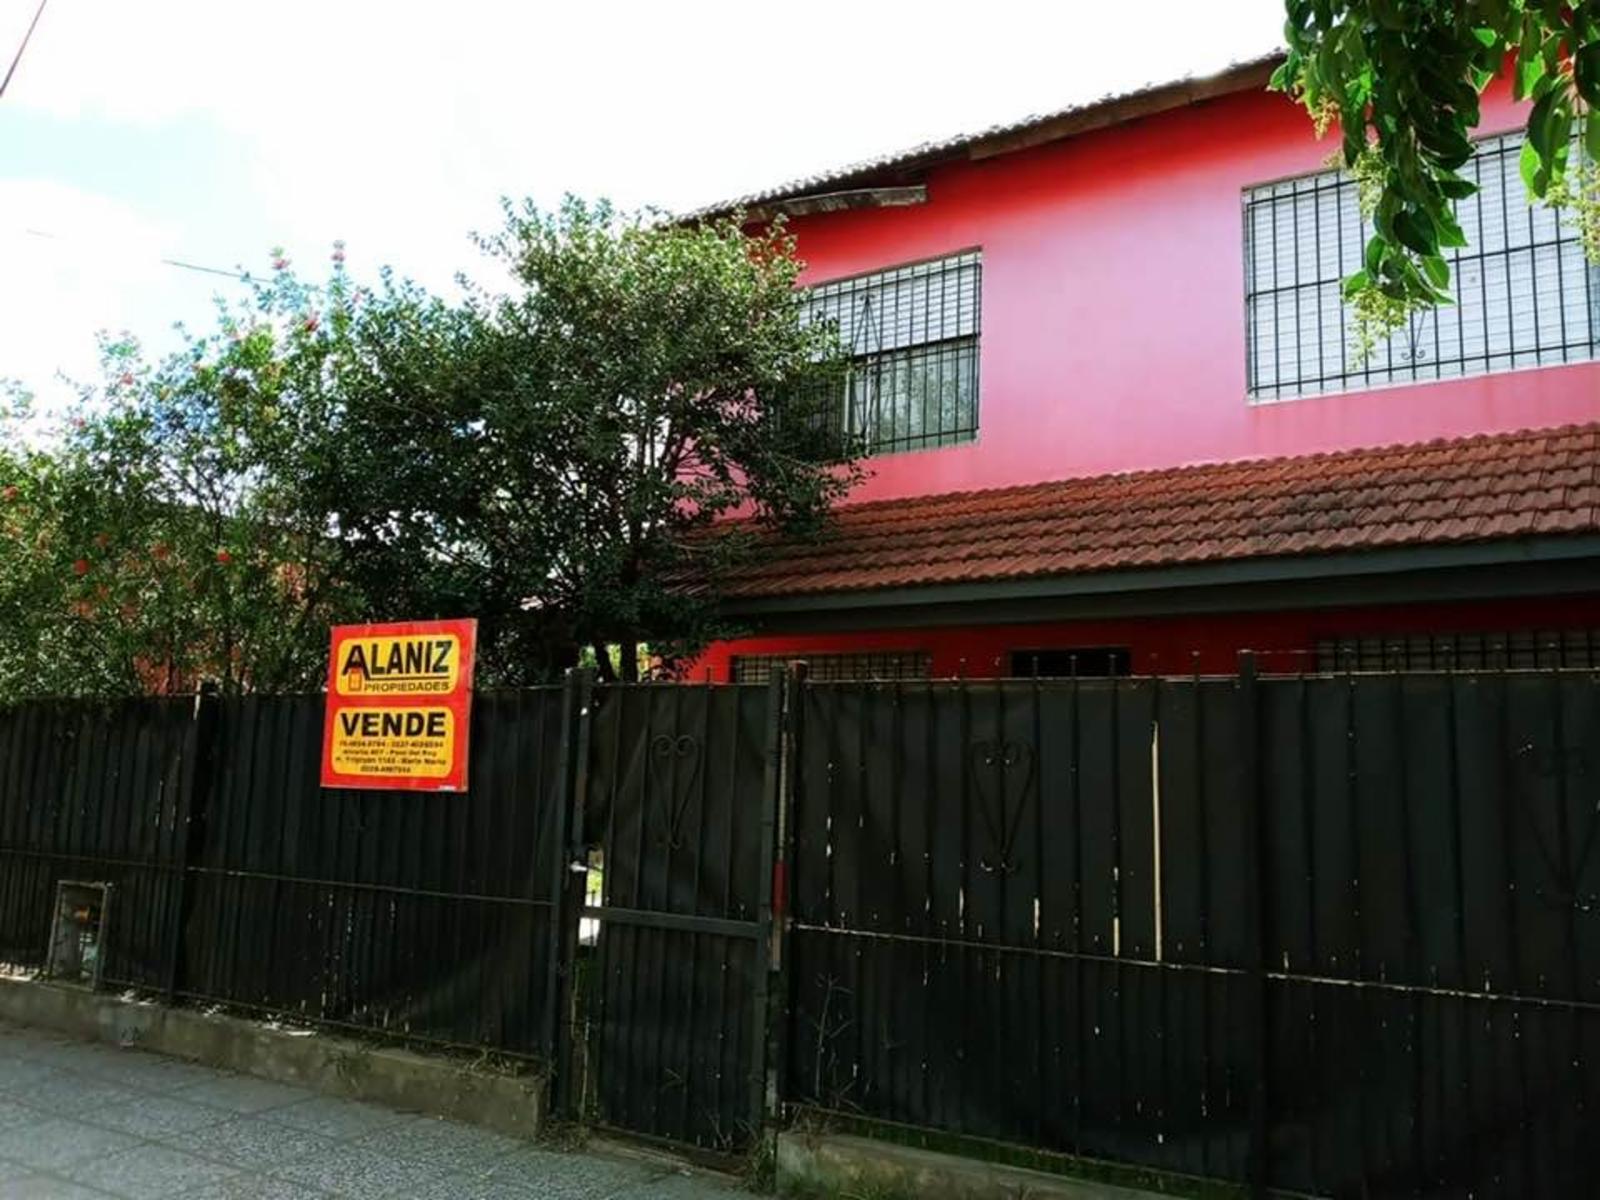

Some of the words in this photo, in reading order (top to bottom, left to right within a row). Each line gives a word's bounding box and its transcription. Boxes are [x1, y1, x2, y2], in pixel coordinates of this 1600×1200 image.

[342, 640, 452, 680] ALANIZ
[364, 681, 450, 692] PROPIEDADES
[340, 712, 447, 737] VENDE
